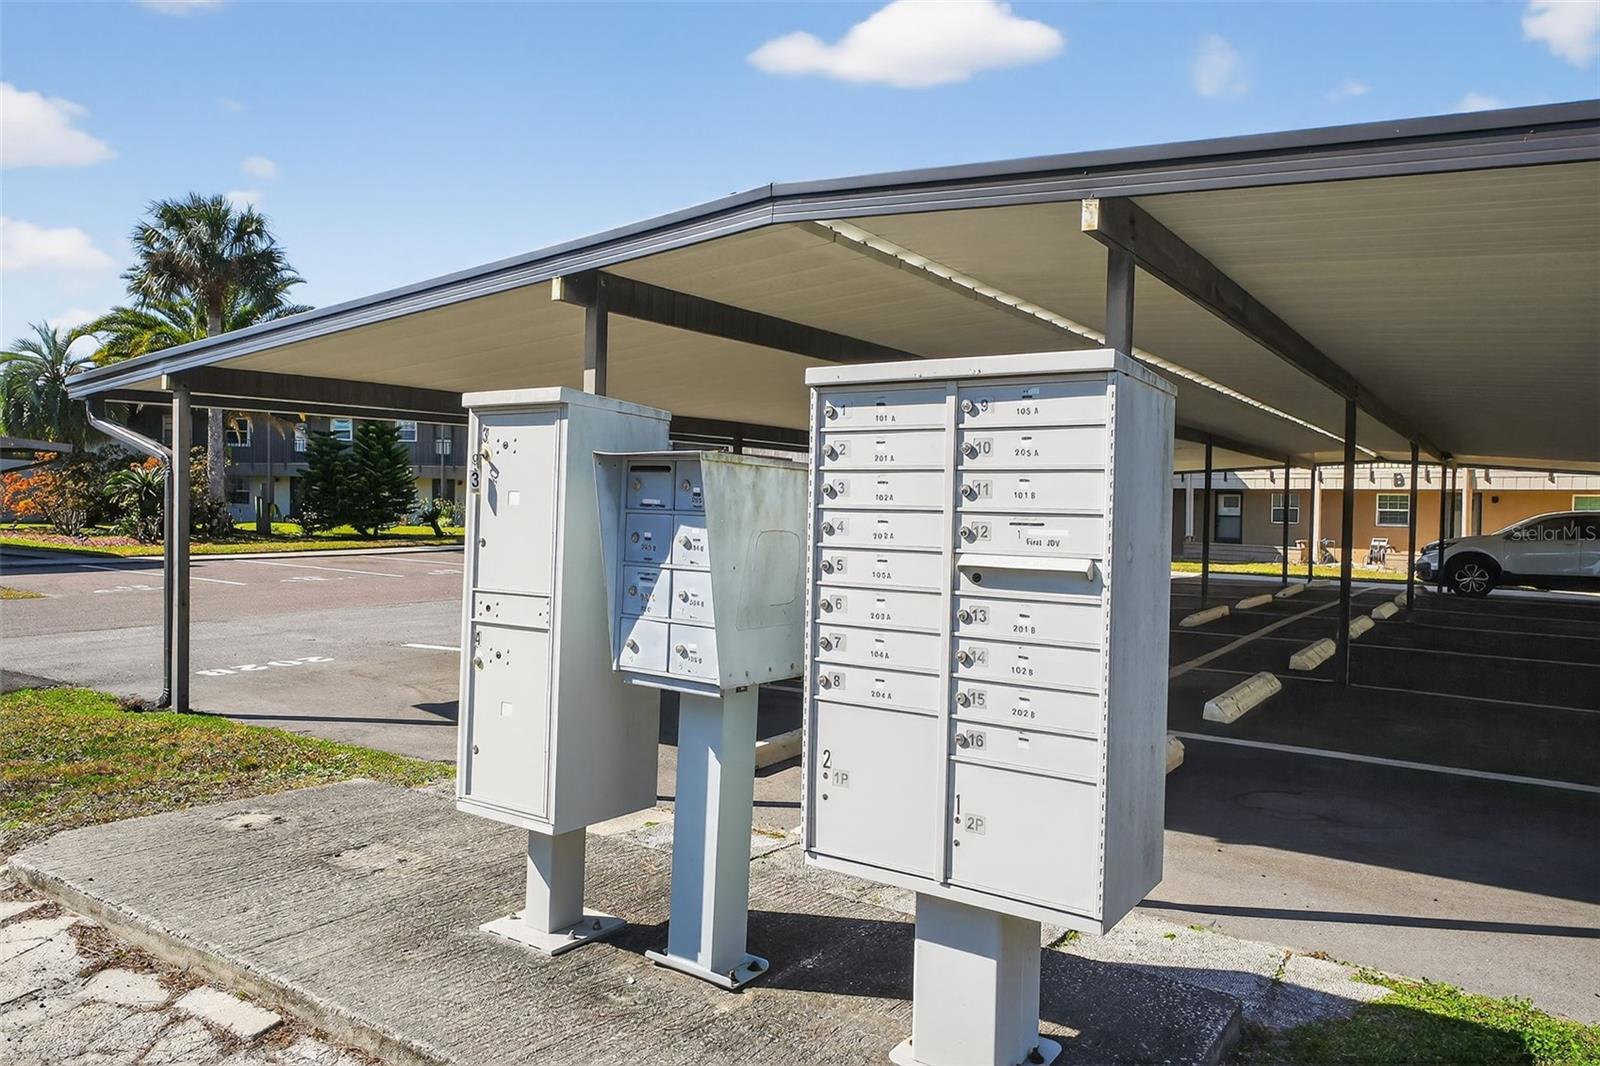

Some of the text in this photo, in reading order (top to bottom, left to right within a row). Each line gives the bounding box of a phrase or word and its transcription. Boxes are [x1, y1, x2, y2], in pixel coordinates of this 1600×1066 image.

[980, 399, 989, 412] 9
[1016, 407, 1031, 416] 105
[875, 414, 888, 423] 101
[839, 443, 846, 456] 2
[975, 441, 991, 455] 10
[1014, 448, 1032, 457] 205
[874, 454, 888, 463] 201
[471, 471, 479, 488] 3
[1393, 472, 1405, 488] B
[838, 481, 846, 494] 3
[974, 482, 989, 496] 11
[1013, 491, 1028, 500] 101
[836, 520, 845, 533] 4
[973, 524, 988, 538] 12
[836, 559, 844, 572] 5
[835, 597, 842, 610] 6
[971, 609, 987, 623] 13
[1012, 624, 1028, 633] 201
[834, 636, 842, 649] 7
[970, 650, 985, 664] 14
[1011, 666, 1027, 675] 102
[833, 674, 841, 688] 8
[969, 691, 985, 706] 15
[1011, 707, 1029, 717] 202
[968, 733, 985, 748] 16
[822, 749, 832, 769] 2
[834, 772, 849, 785] 1P
[955, 794, 961, 815] 1
[967, 816, 984, 831] 2P
